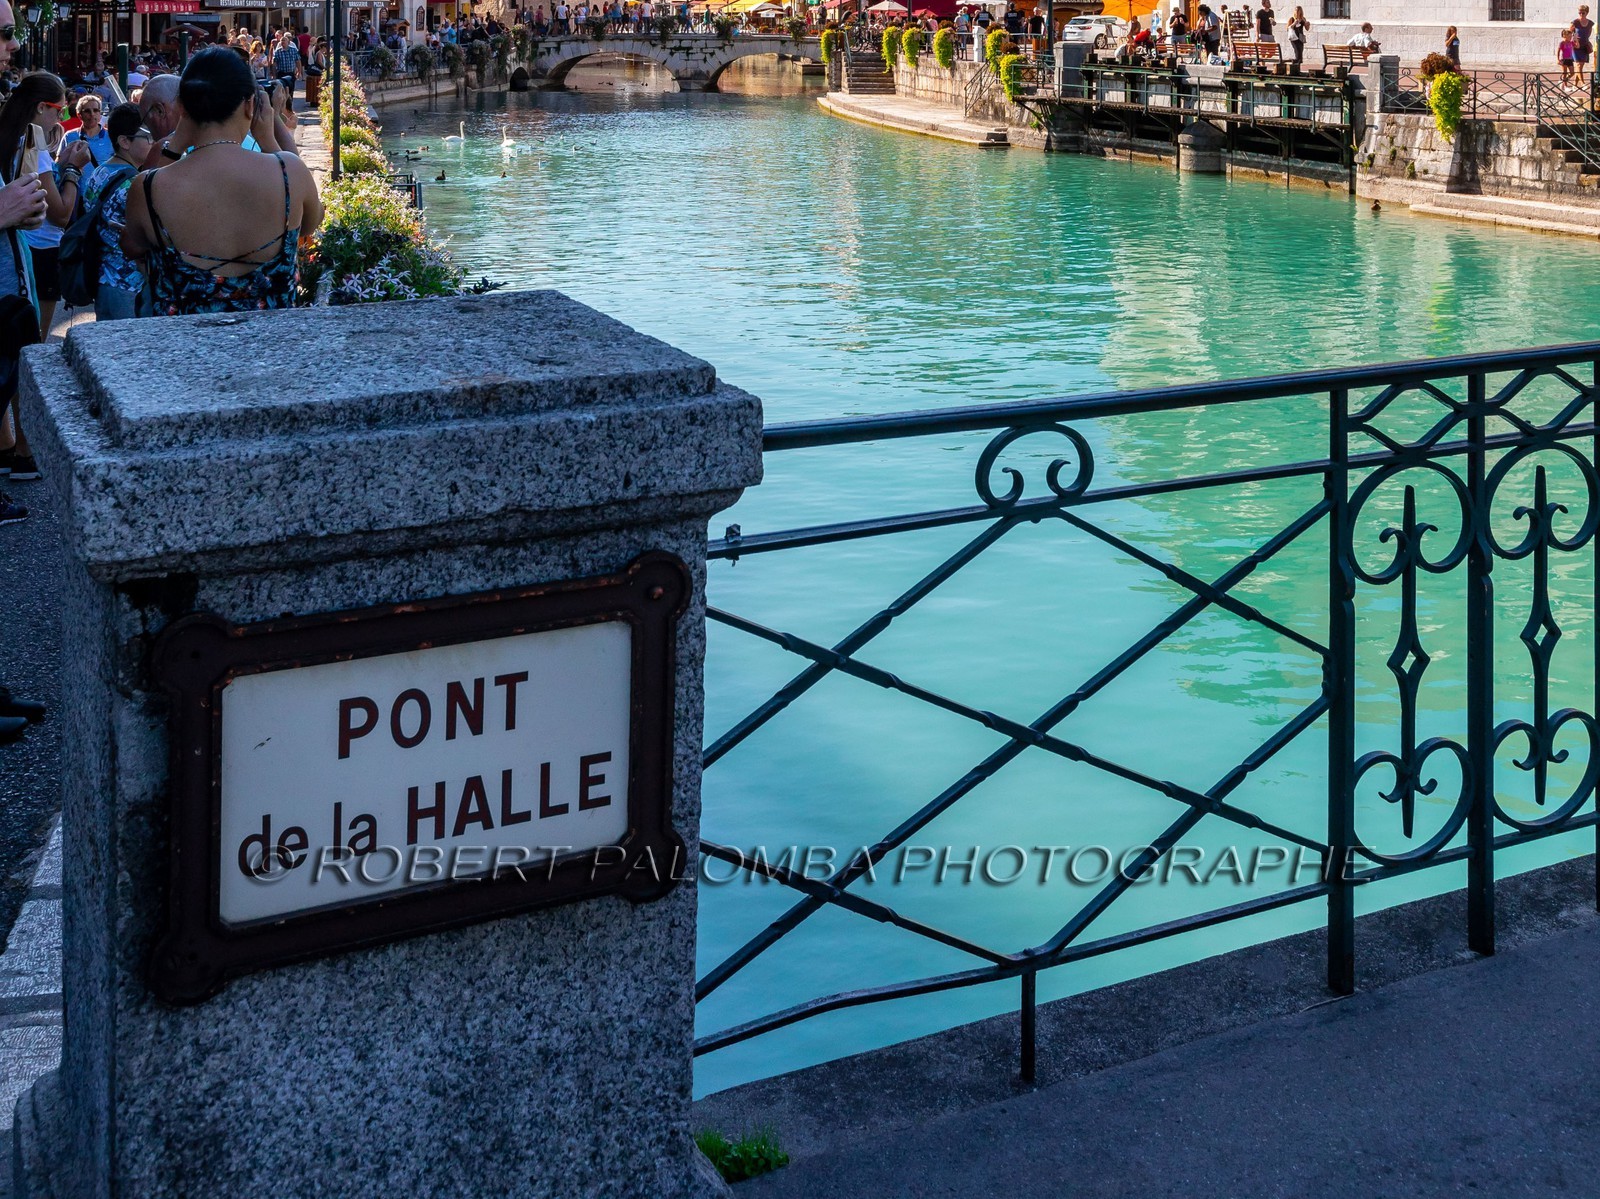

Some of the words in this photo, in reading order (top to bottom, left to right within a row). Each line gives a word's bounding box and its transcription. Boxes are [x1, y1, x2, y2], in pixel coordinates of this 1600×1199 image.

[338, 671, 529, 760] PONT
[238, 814, 309, 877] de
[333, 801, 378, 860] la
[407, 751, 612, 846] HALLE
